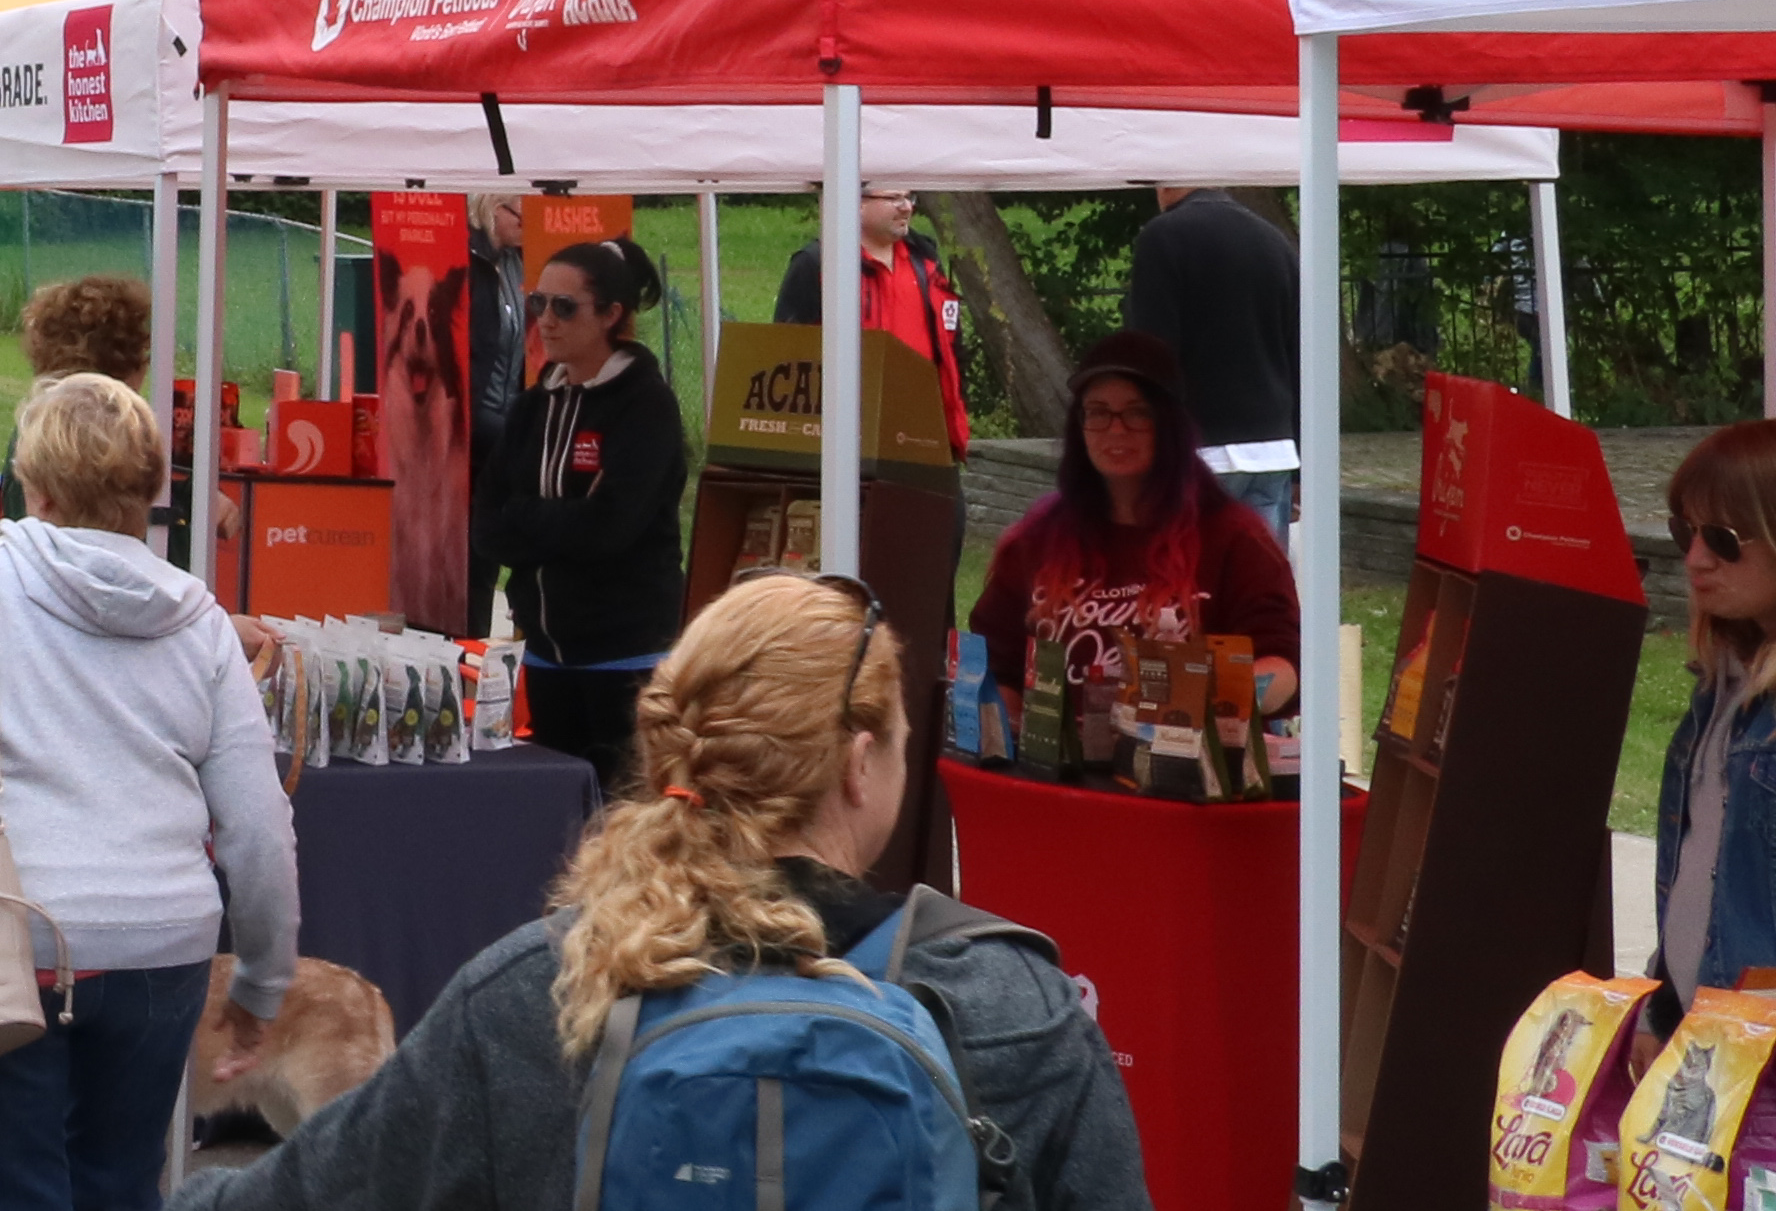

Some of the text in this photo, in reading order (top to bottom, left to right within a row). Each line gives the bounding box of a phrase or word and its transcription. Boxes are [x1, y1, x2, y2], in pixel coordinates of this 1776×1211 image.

[69, 45, 84, 68] the
[68, 71, 106, 96] honest
[68, 98, 108, 123] kitchen
[743, 360, 821, 414] ACA
[739, 418, 786, 433] FRESH
[1493, 1114, 1552, 1169] Lara
